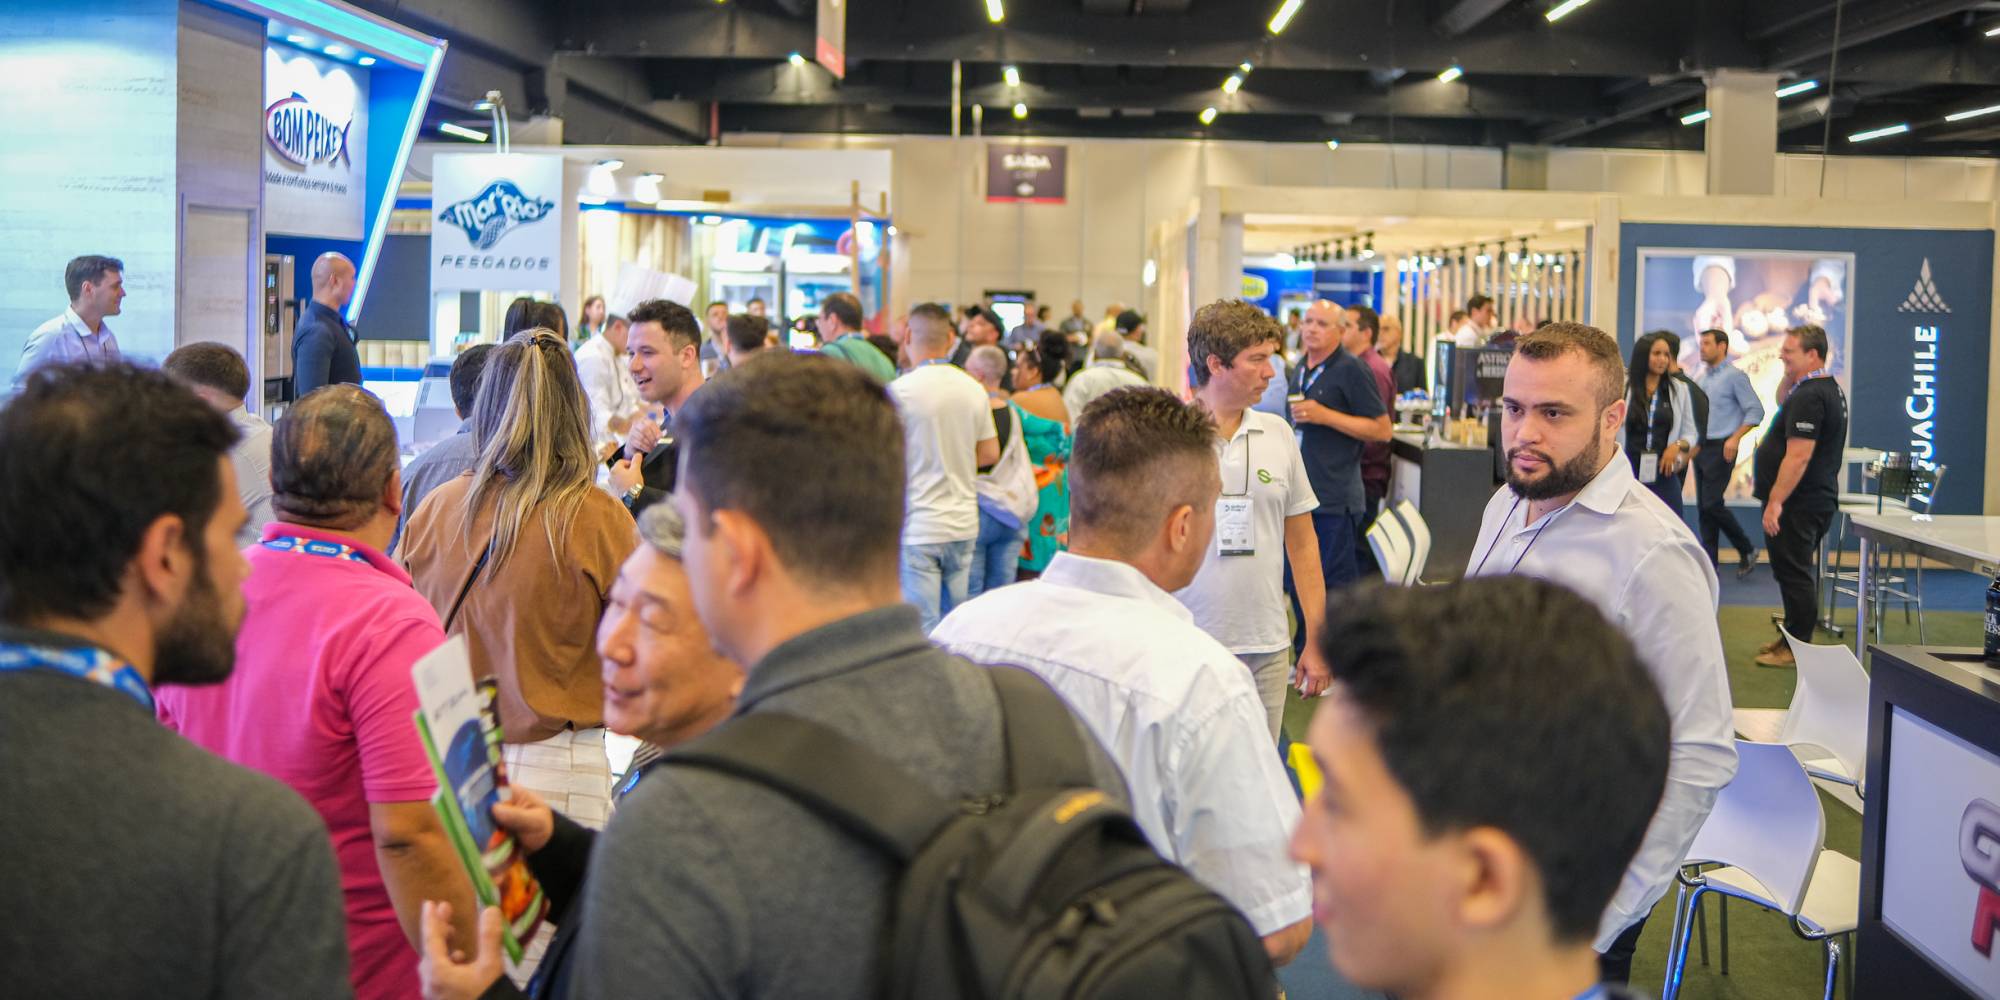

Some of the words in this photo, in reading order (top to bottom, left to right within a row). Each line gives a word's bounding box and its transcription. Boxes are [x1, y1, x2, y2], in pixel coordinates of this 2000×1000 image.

[274, 107, 303, 157] BOM
[306, 109, 338, 159] PEIXE
[440, 255, 550, 271] PESCADOS
